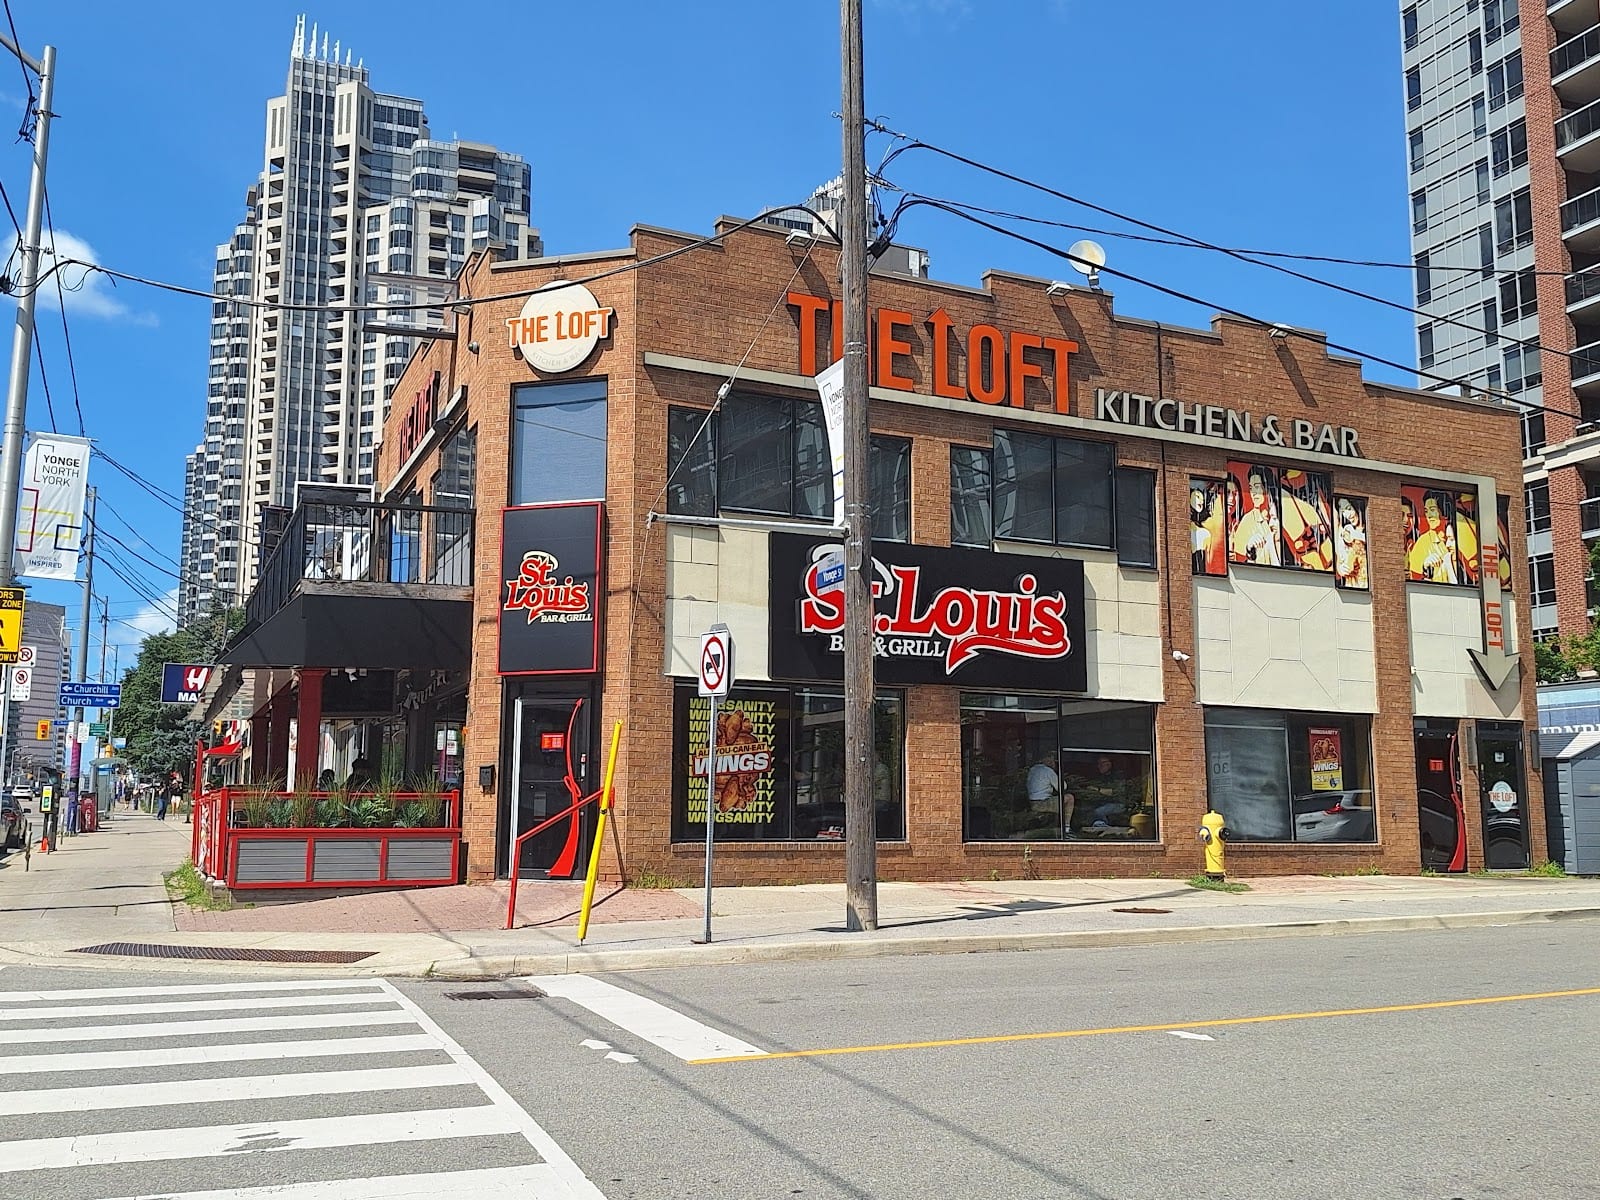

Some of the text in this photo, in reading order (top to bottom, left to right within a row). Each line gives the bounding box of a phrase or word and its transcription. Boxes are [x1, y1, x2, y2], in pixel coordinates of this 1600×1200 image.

[508, 309, 612, 346] THE LOFT
[927, 307, 1078, 414] LOFT
[1096, 388, 1360, 457] KITCHEN & BAR
[43, 454, 80, 467] YONGE
[42, 465, 79, 478] NORTH
[42, 474, 71, 487] YORK
[29, 559, 62, 569] INSPIRED
[519, 557, 556, 588] St.
[504, 576, 590, 610] Louis
[1482, 543, 1504, 650] THE LOFT
[2, 600, 22, 609] ZONE
[890, 566, 1070, 646] Louis
[74, 684, 109, 694] Churchill
[61, 696, 92, 705] Church
[689, 698, 775, 712] WIGSANITY
[1313, 762, 1339, 771] WINGS
[688, 812, 775, 823] WIGSANITY
